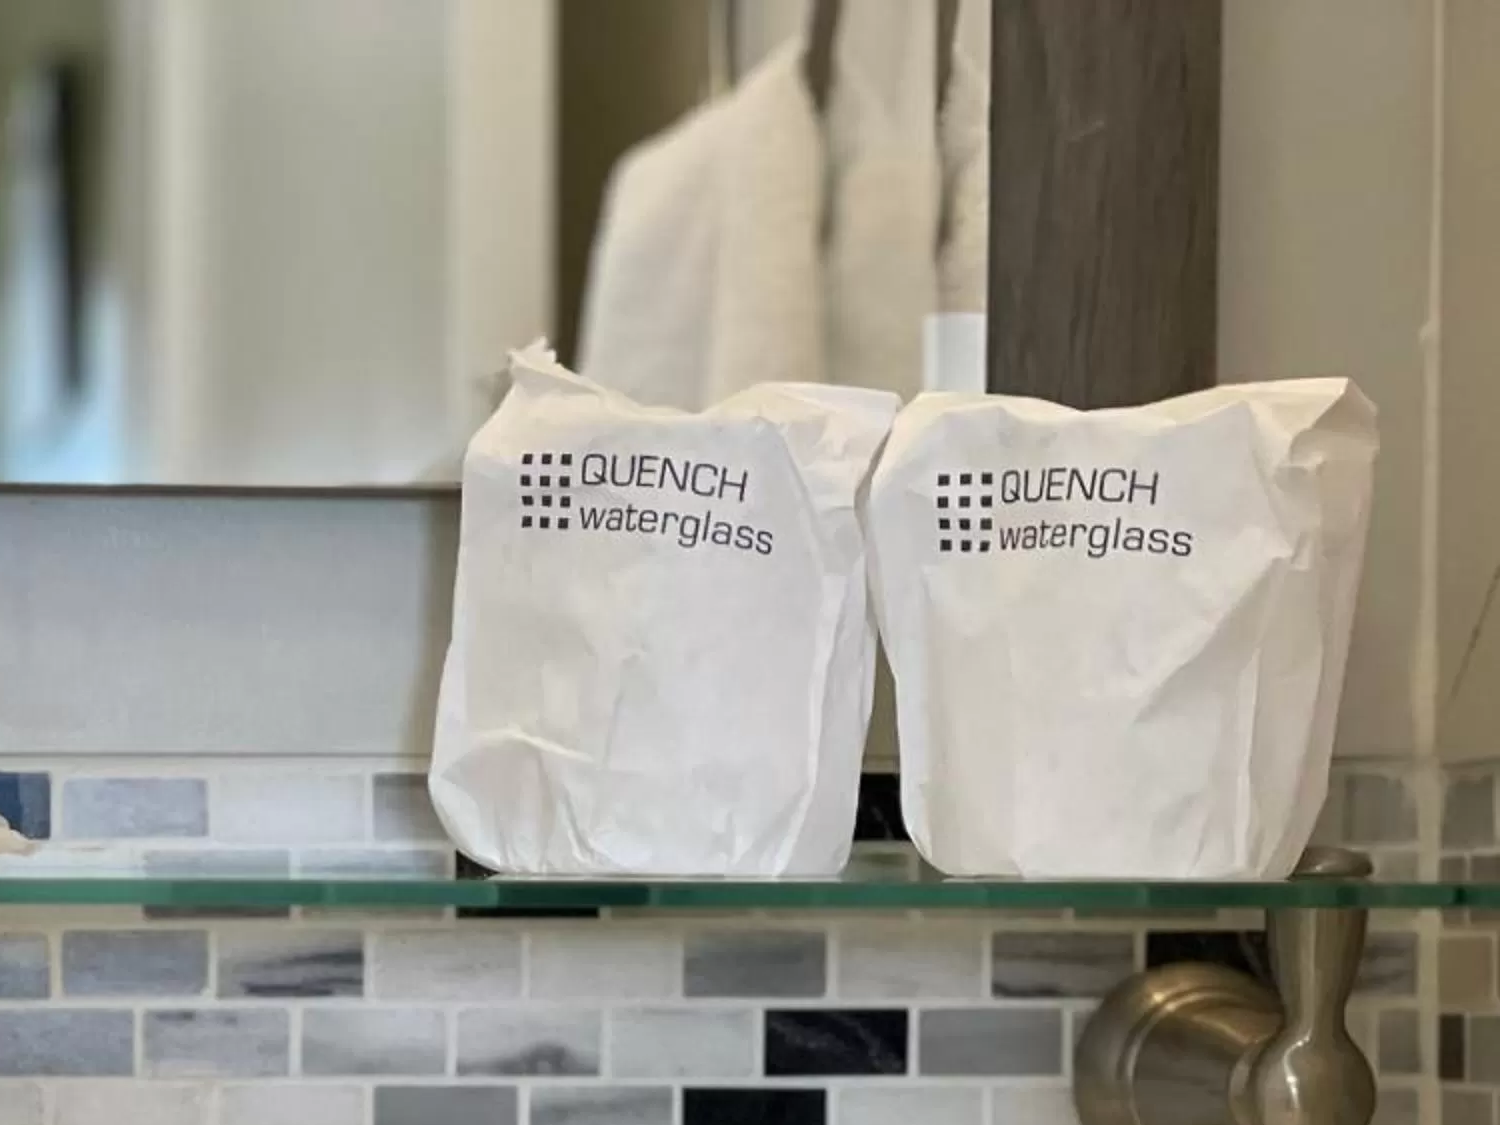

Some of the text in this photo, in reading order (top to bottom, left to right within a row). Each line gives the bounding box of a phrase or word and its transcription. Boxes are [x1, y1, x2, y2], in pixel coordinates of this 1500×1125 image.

[581, 453, 748, 501] QUENCH
[1001, 467, 1159, 505] QUENCH
[579, 504, 773, 555] waterglass
[999, 517, 1193, 558] waterglass
